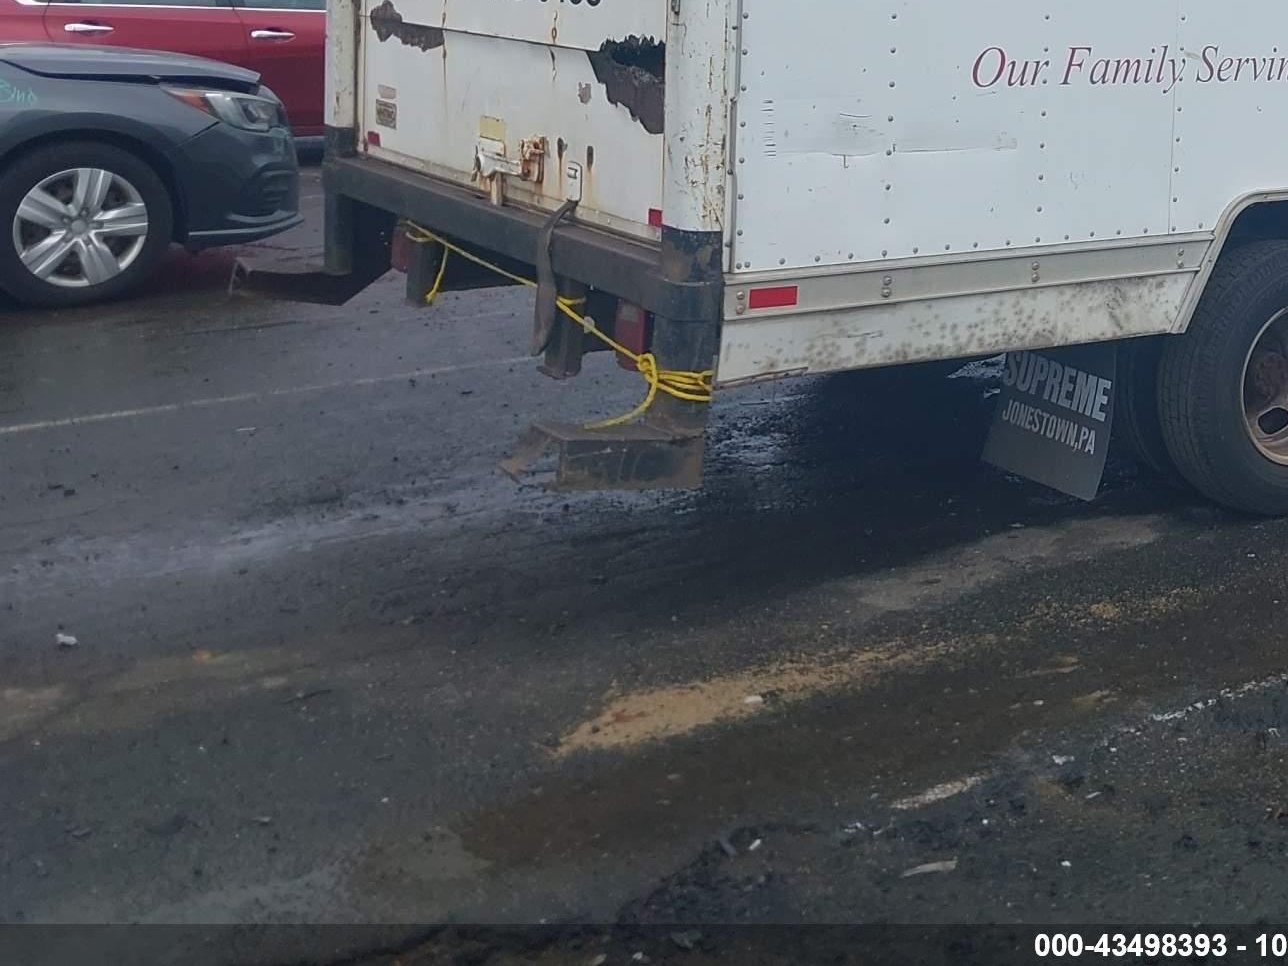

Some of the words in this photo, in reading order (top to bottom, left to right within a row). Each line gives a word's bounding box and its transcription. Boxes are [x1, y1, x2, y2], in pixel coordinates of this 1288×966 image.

[971, 46, 1047, 89] Our
[1059, 45, 1185, 94] Family
[1003, 352, 1113, 422] SUPREME
[1002, 399, 1096, 455] JONESTOWN,PA
